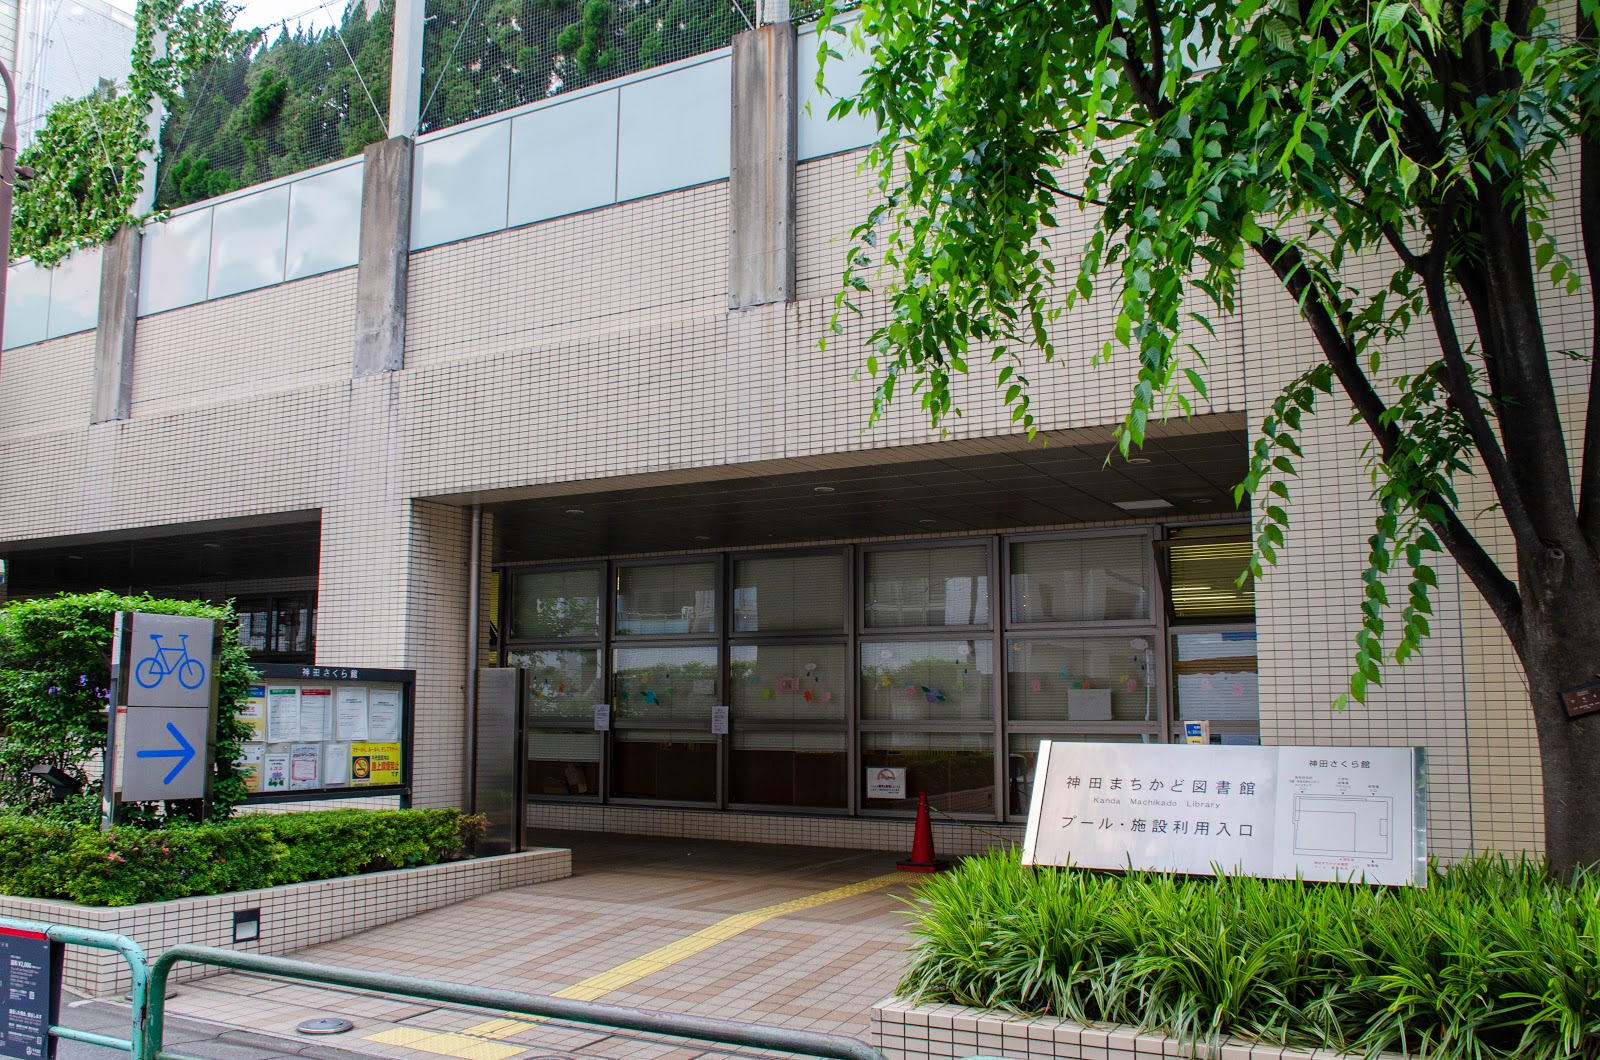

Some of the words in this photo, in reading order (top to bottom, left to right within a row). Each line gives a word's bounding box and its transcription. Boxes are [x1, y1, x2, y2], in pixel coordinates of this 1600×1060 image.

[302, 667, 358, 679] 神田さくら館
[1309, 759, 1371, 769] 神田さくら館
[1066, 775, 1256, 796] 神田まちかど図書館
[1093, 796, 1121, 805] Kanda
[1130, 798, 1178, 807] Machikado
[1186, 800, 1221, 809] Library
[1061, 814, 1253, 837] プール・施設利用入口
